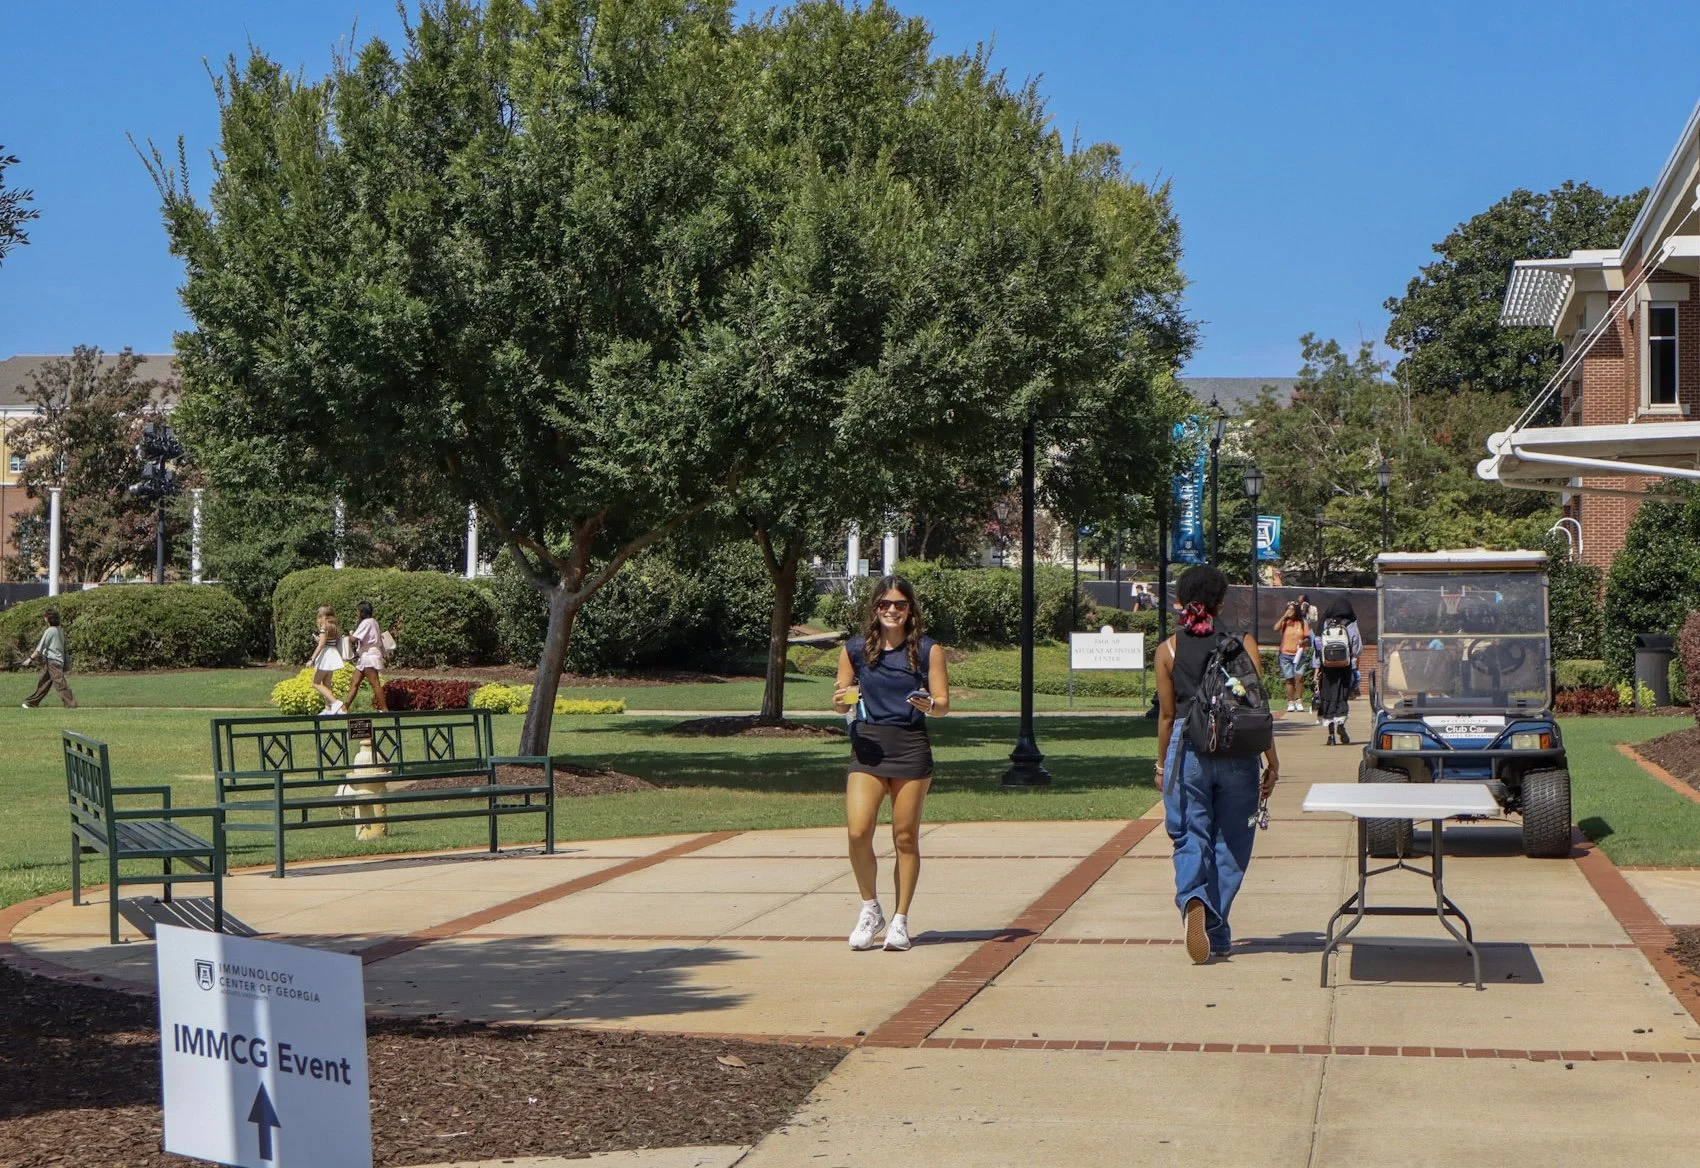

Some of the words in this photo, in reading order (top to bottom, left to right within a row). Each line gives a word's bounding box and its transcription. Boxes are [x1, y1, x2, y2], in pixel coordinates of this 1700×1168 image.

[1445, 725, 1467, 733] Club
[1469, 725, 1486, 733] Car
[219, 963, 294, 985] IMMUNOLOGY
[219, 977, 256, 993] CENTER
[260, 983, 273, 996] OF
[276, 987, 321, 1003] GEORGIA
[174, 1023, 268, 1068] IMMCG
[277, 1042, 352, 1085] Event
